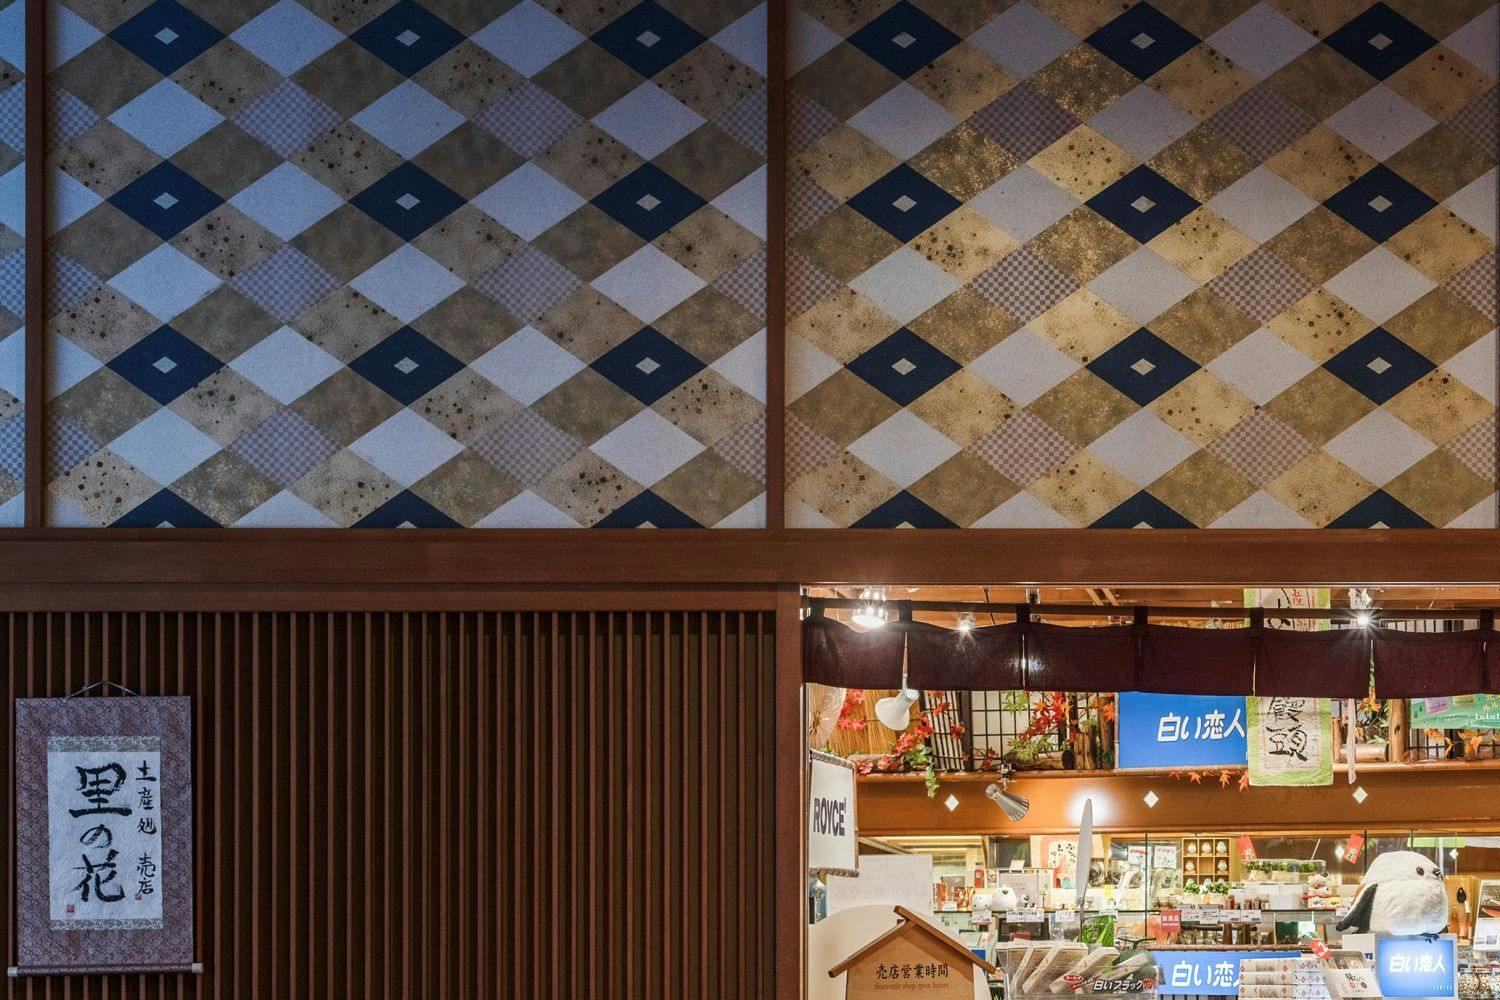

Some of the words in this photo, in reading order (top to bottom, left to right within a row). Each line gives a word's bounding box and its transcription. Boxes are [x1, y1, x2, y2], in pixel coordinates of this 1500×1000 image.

[1157, 708, 1246, 743] 白い恋人
[136, 760, 157, 835] 土産処
[69, 762, 132, 902] 里の花
[136, 852, 156, 894] 売店
[876, 963, 949, 979] 売店営業時間
[1389, 951, 1446, 974] 白い恋人
[902, 982, 917, 991] shop
